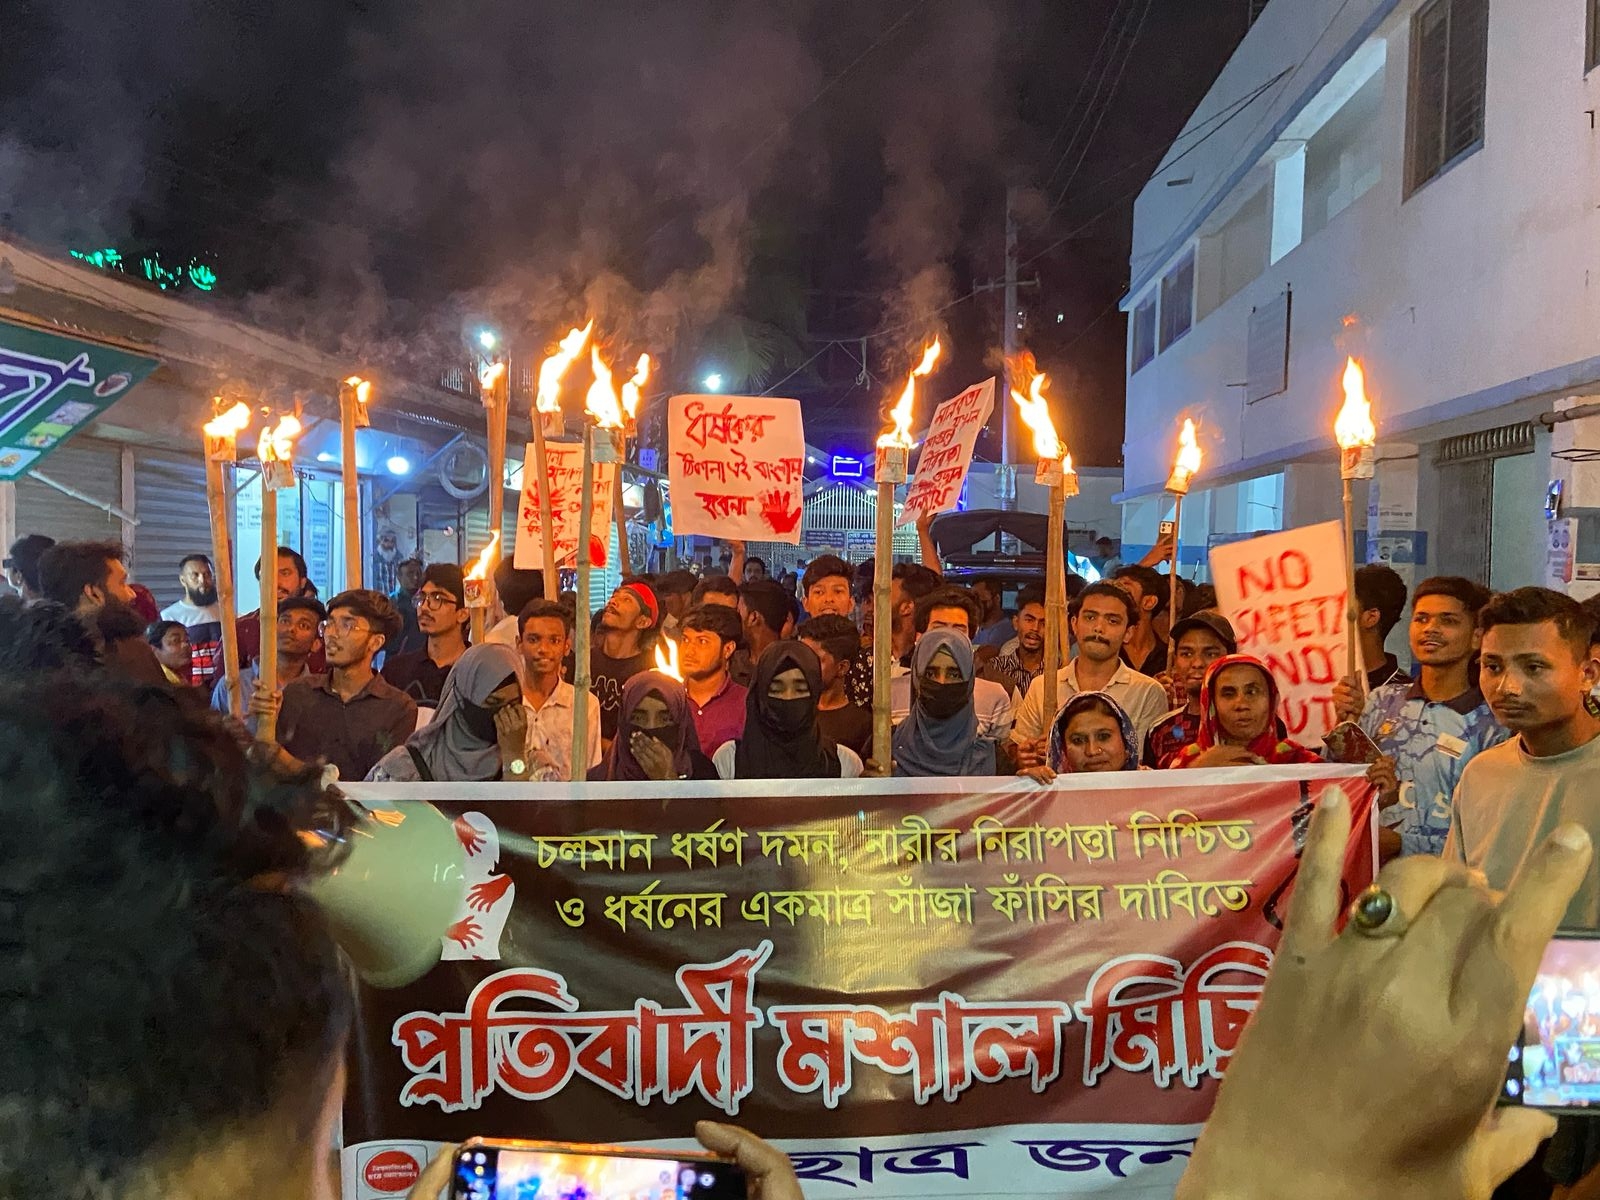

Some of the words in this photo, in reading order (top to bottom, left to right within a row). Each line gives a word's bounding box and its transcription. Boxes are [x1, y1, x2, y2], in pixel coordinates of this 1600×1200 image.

[683, 401, 776, 449] ধর্ষকের
[726, 448, 752, 482] এই
[1237, 549, 1312, 600] NO
[533, 829, 657, 871] চলমান
[671, 818, 749, 869] ধর্ষণ
[757, 829, 848, 874] দমন,
[860, 814, 961, 865] নারীর
[970, 815, 1119, 865] নিরাপত্তা
[1126, 808, 1256, 860] নিশ্চিত
[555, 898, 585, 928] ও
[604, 880, 728, 934] ধর্ষনের
[741, 884, 876, 928] একমাত্র
[887, 874, 977, 926] সাঁজা
[985, 873, 1104, 923] ফাঁসির
[1114, 869, 1254, 920] দাবিতে
[392, 939, 775, 1117] প্রতিবাদী
[767, 991, 1074, 1110] মশাল
